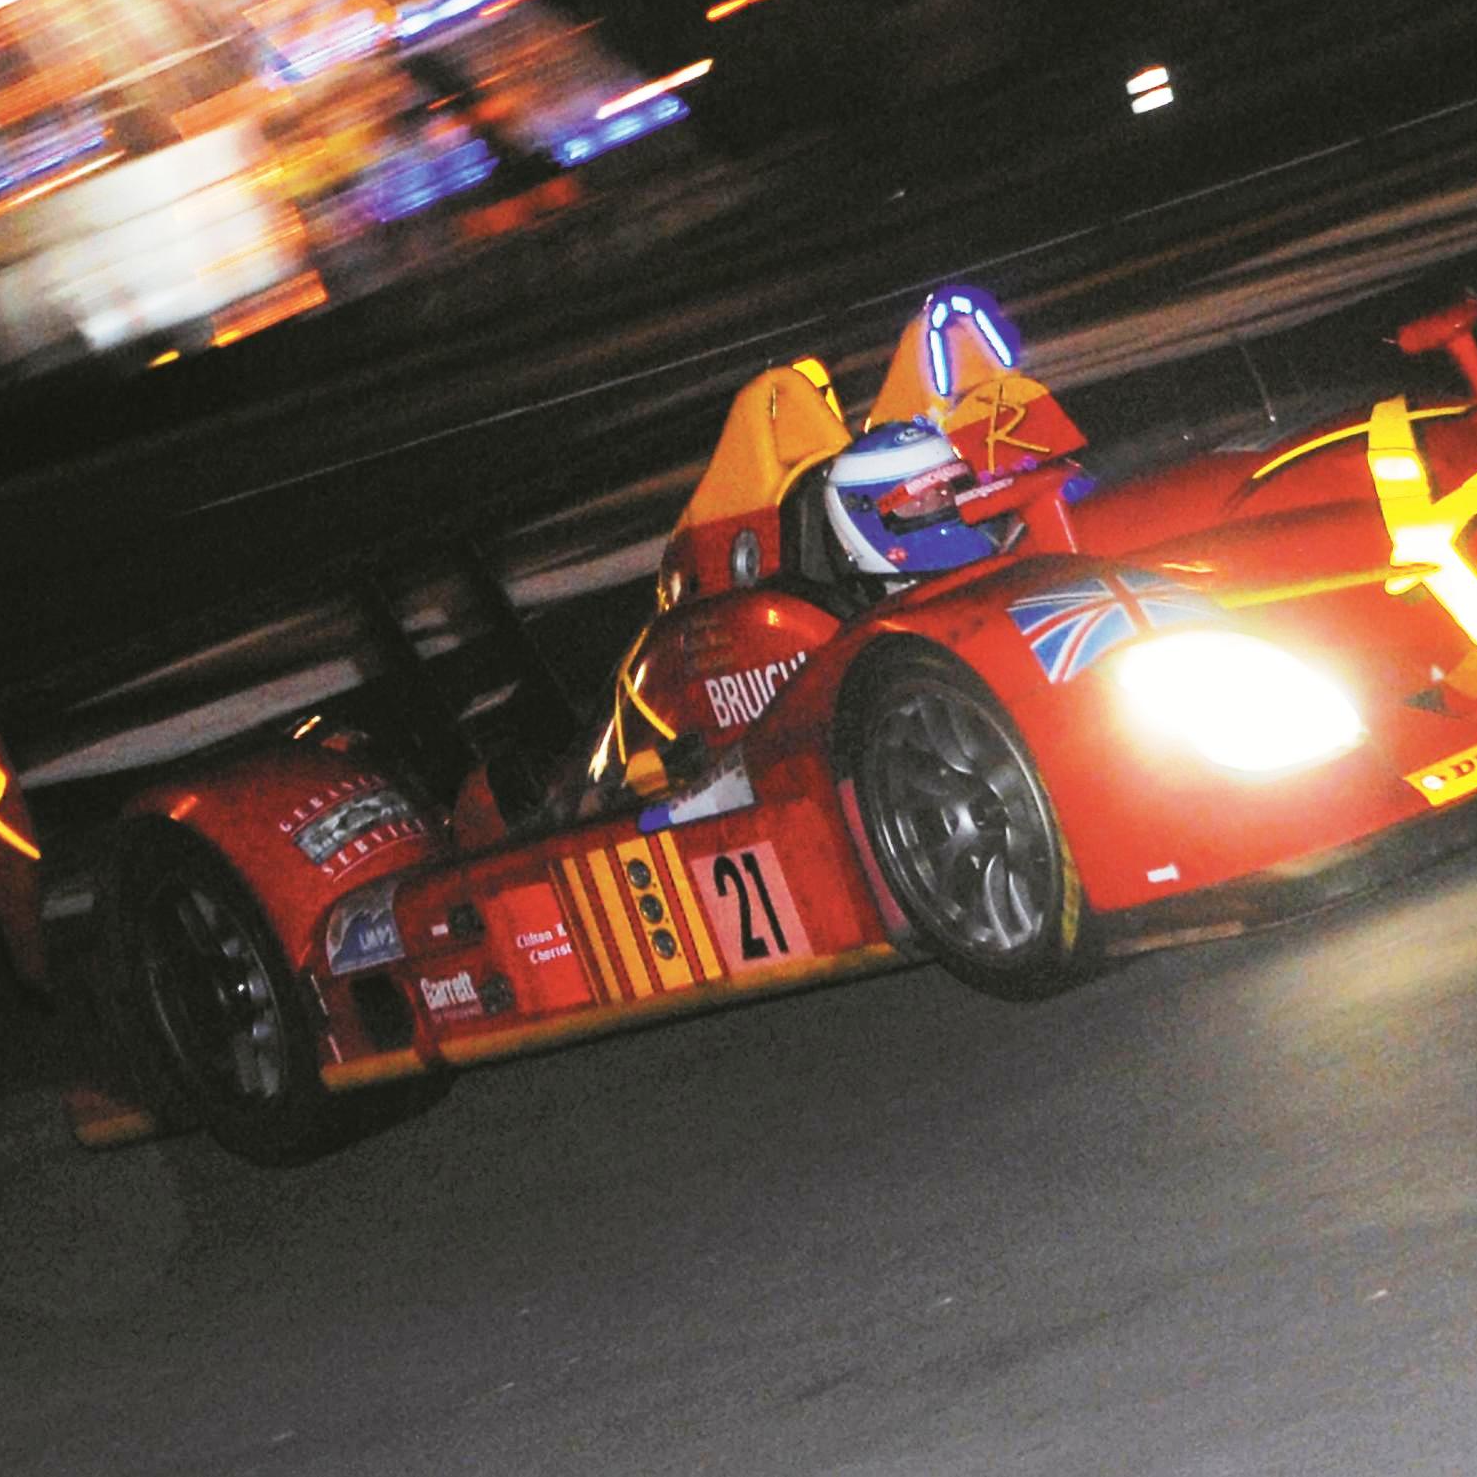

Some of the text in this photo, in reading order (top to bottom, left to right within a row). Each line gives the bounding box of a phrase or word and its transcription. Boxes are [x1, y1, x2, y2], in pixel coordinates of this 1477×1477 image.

[976, 383, 1051, 474] R
[705, 651, 806, 728] BRUIC
[713, 851, 789, 961] 21
[420, 971, 477, 1010] Garrett
